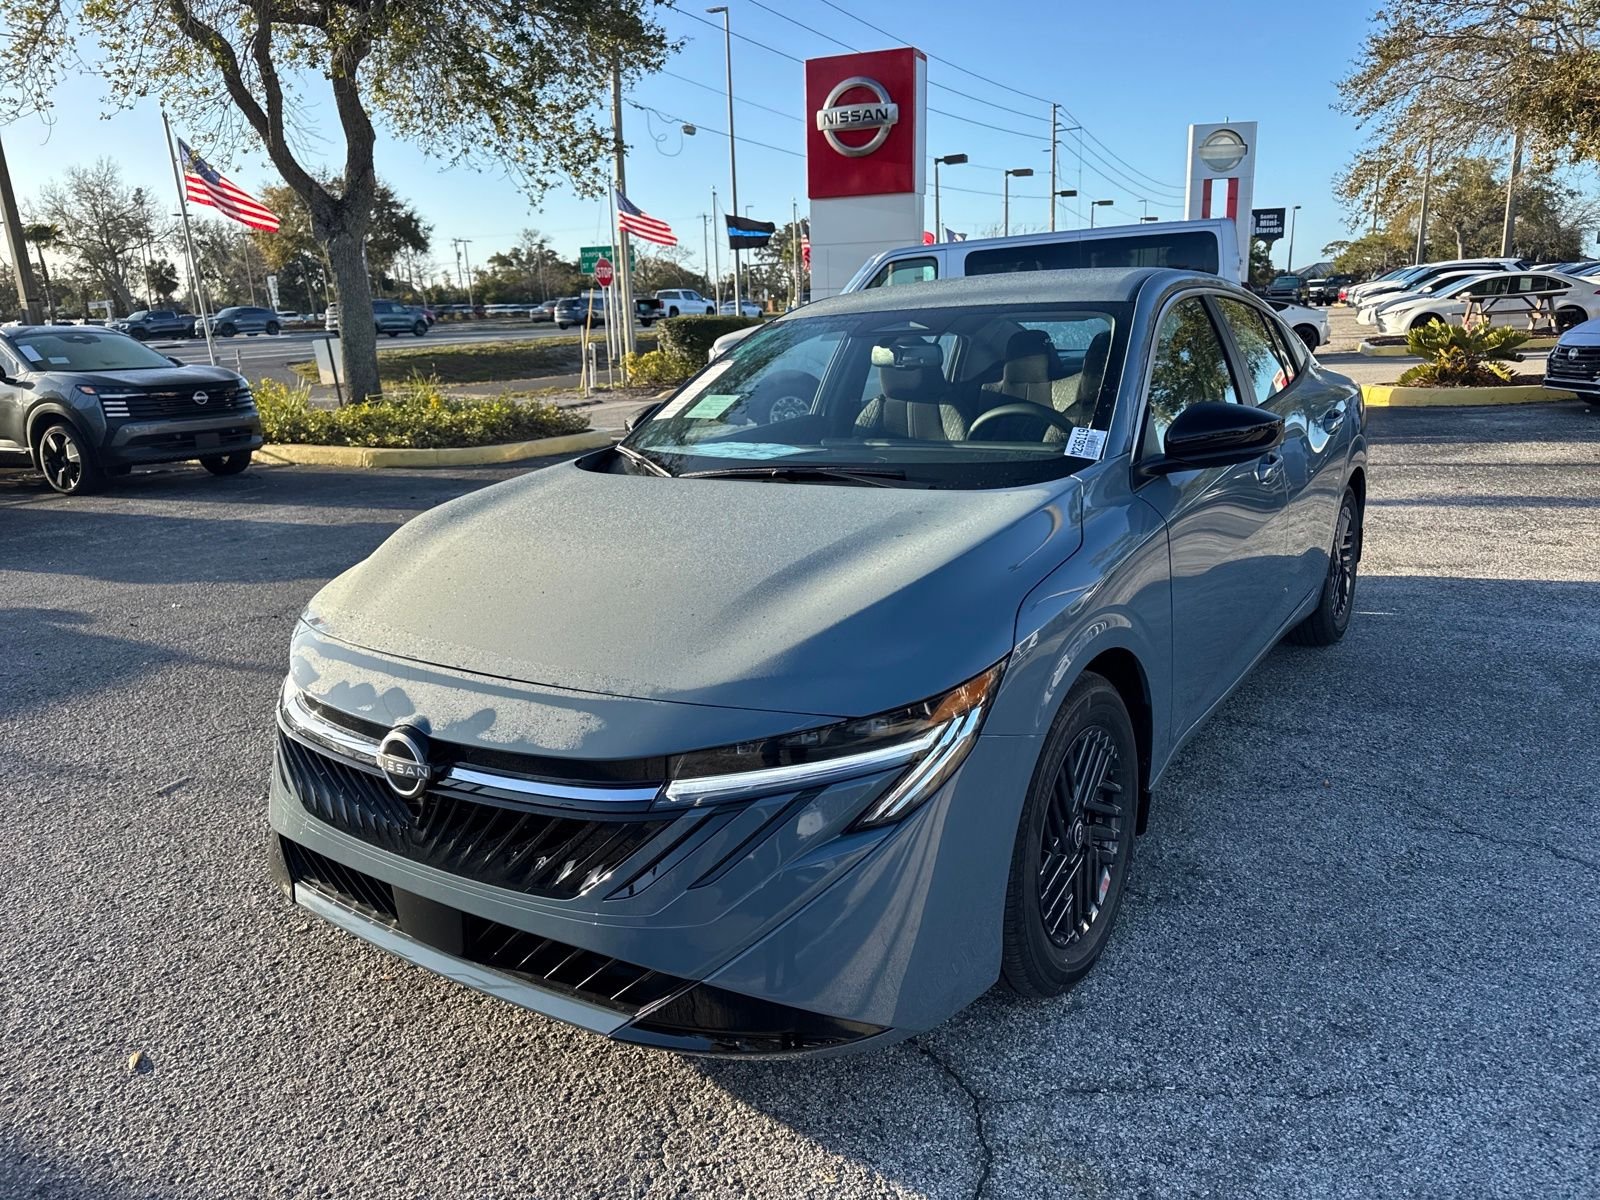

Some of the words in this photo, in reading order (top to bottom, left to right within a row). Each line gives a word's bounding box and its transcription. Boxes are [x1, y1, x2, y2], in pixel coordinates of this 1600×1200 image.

[824, 108, 888, 125] NISSAN
[596, 267, 612, 279] STOP
[378, 757, 428, 778] NISSAN
